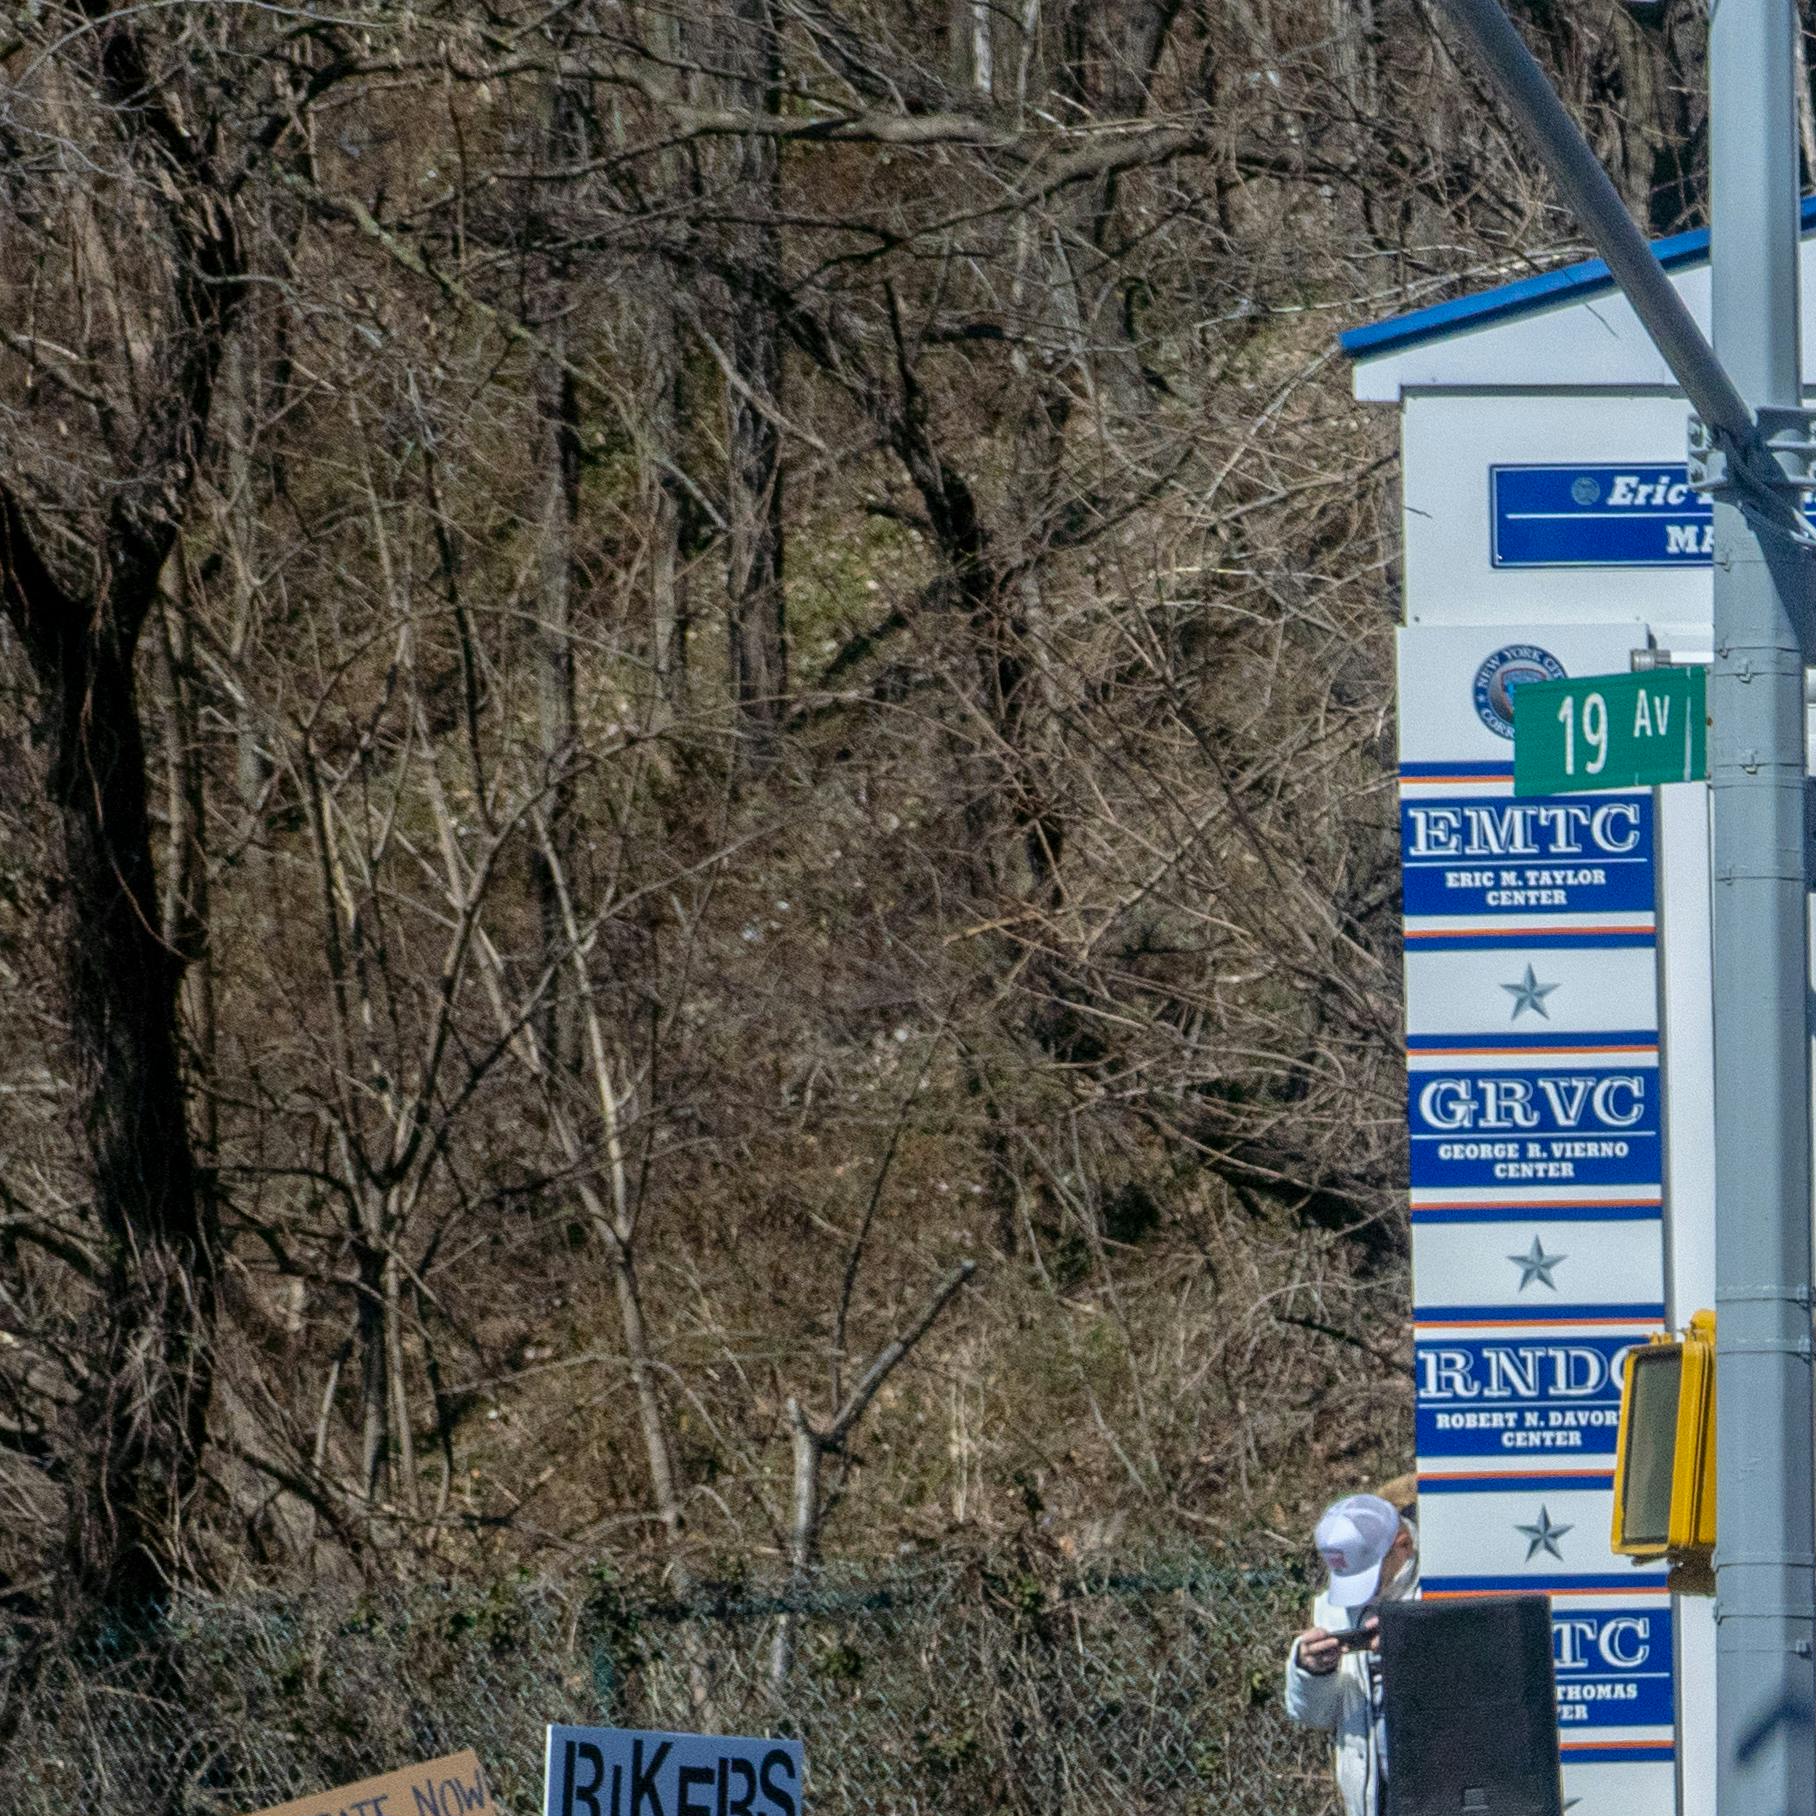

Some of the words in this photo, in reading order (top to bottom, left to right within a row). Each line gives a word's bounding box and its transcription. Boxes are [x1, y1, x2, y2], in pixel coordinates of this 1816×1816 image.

[1607, 476, 1687, 506] Eric
[1477, 662, 1501, 691] NEW
[1503, 646, 1541, 662] YORK
[1543, 651, 1566, 678] CIT
[1558, 693, 1608, 775] 19
[1408, 804, 1640, 855] EMTC
[1446, 872, 1494, 887] ERIC
[1501, 872, 1523, 886] M.
[1527, 870, 1606, 885] TAYLOR
[1487, 890, 1567, 906] CENTER
[1420, 1076, 1645, 1130] GRVC
[1438, 1145, 1519, 1160] GEORGE
[1527, 1143, 1547, 1159] R.
[1552, 1142, 1628, 1157] VIERNO
[1495, 1162, 1574, 1178] CENTER
[1436, 1412, 1516, 1428] ROBERT
[1525, 1411, 1546, 1427] N.
[1549, 1410, 1619, 1427] DAVOR
[1502, 1431, 1582, 1447] CENTER
[1551, 1617, 1650, 1669] TC
